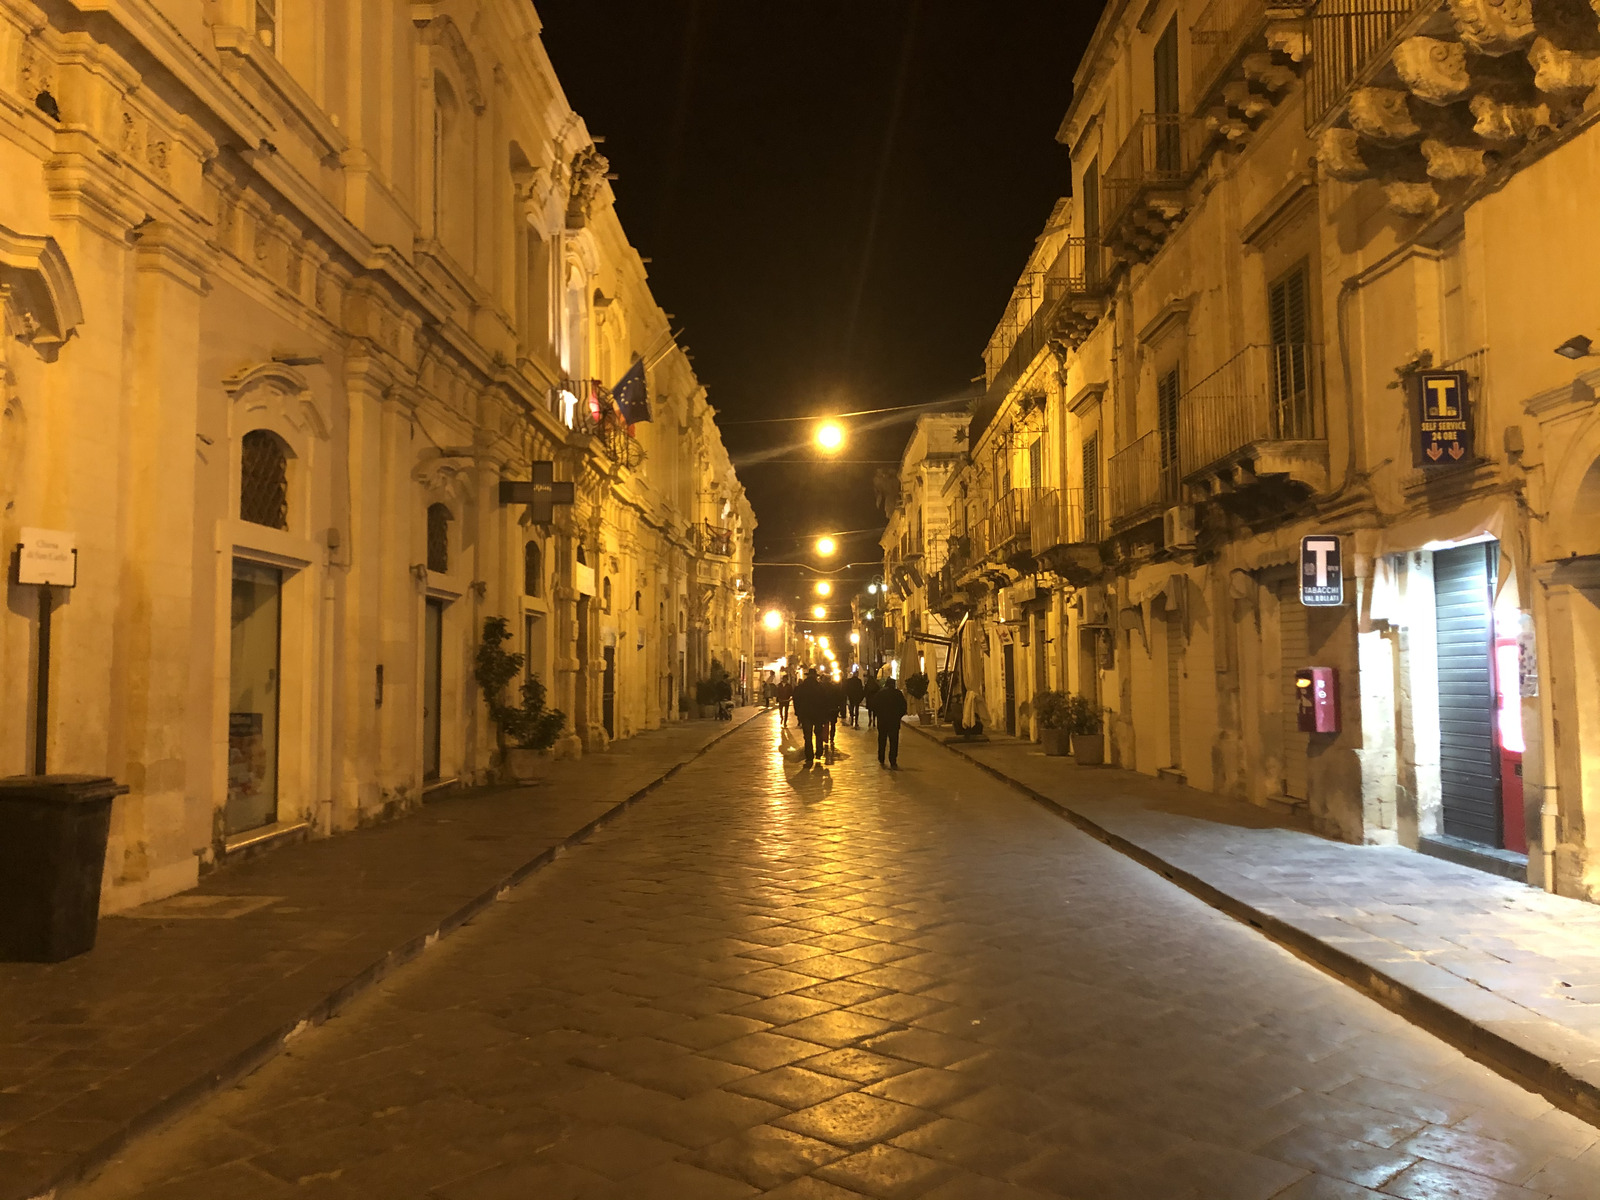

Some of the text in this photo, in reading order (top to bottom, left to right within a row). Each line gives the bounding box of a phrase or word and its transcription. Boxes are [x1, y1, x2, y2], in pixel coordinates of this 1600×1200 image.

[1427, 379, 1455, 416] T
[1421, 421, 1466, 431] SELF SERVICE
[1431, 431, 1457, 440] 24 ORE
[1307, 541, 1335, 586] T
